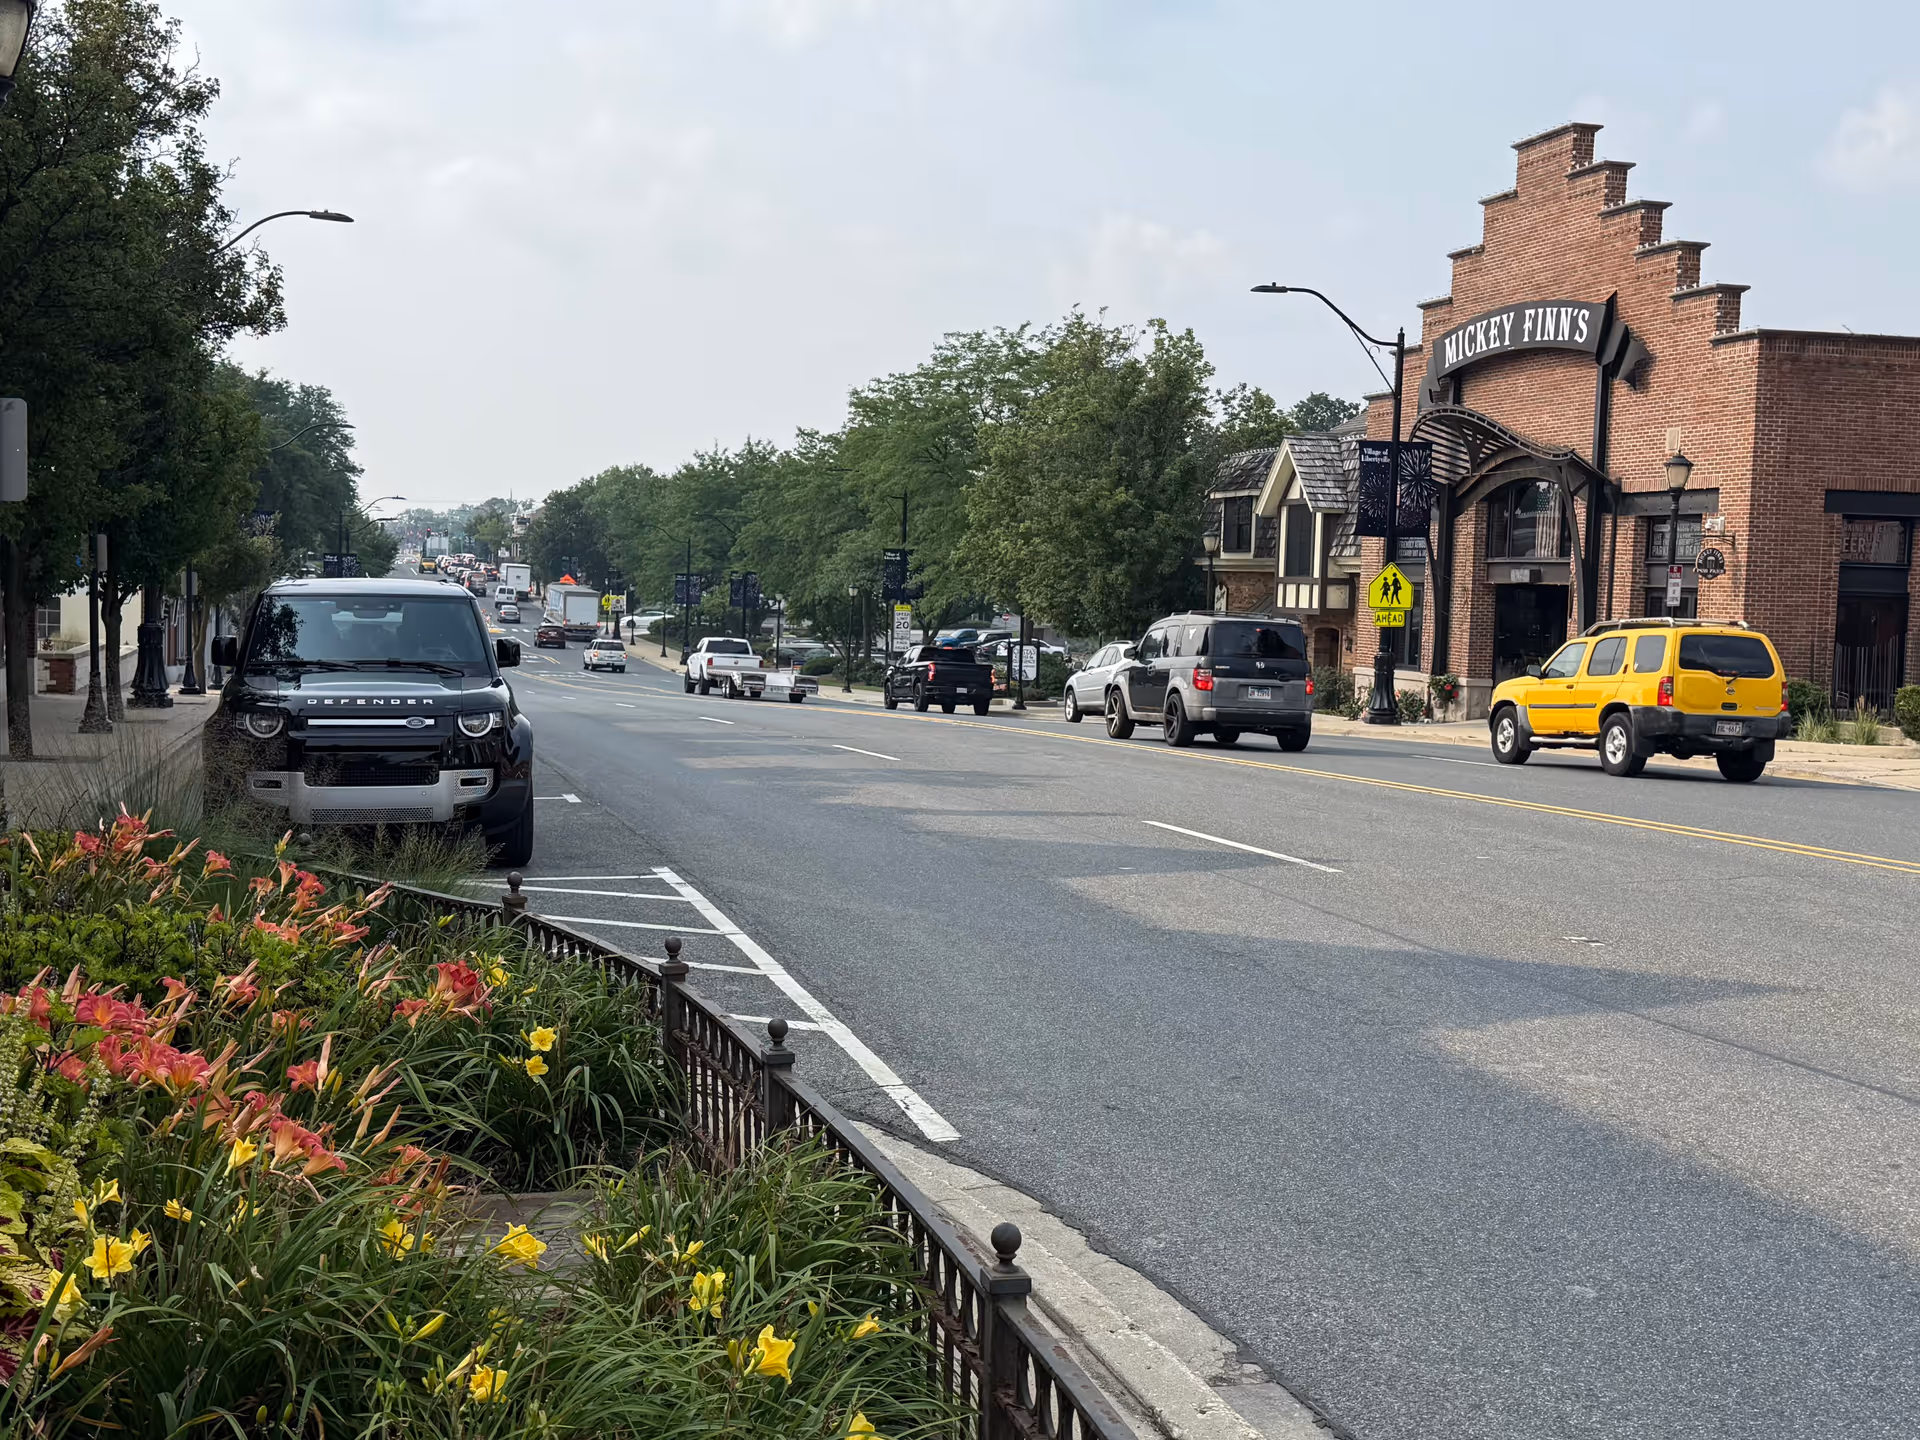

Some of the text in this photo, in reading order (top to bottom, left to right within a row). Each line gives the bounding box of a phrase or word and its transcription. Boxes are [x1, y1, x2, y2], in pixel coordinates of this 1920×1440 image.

[1444, 307, 1590, 368] MICKEY FINN'S
[1363, 448, 1381, 456] Village
[1843, 537, 1866, 552] EER
[1376, 613, 1403, 623] AHEAD
[896, 621, 909, 630] 20
